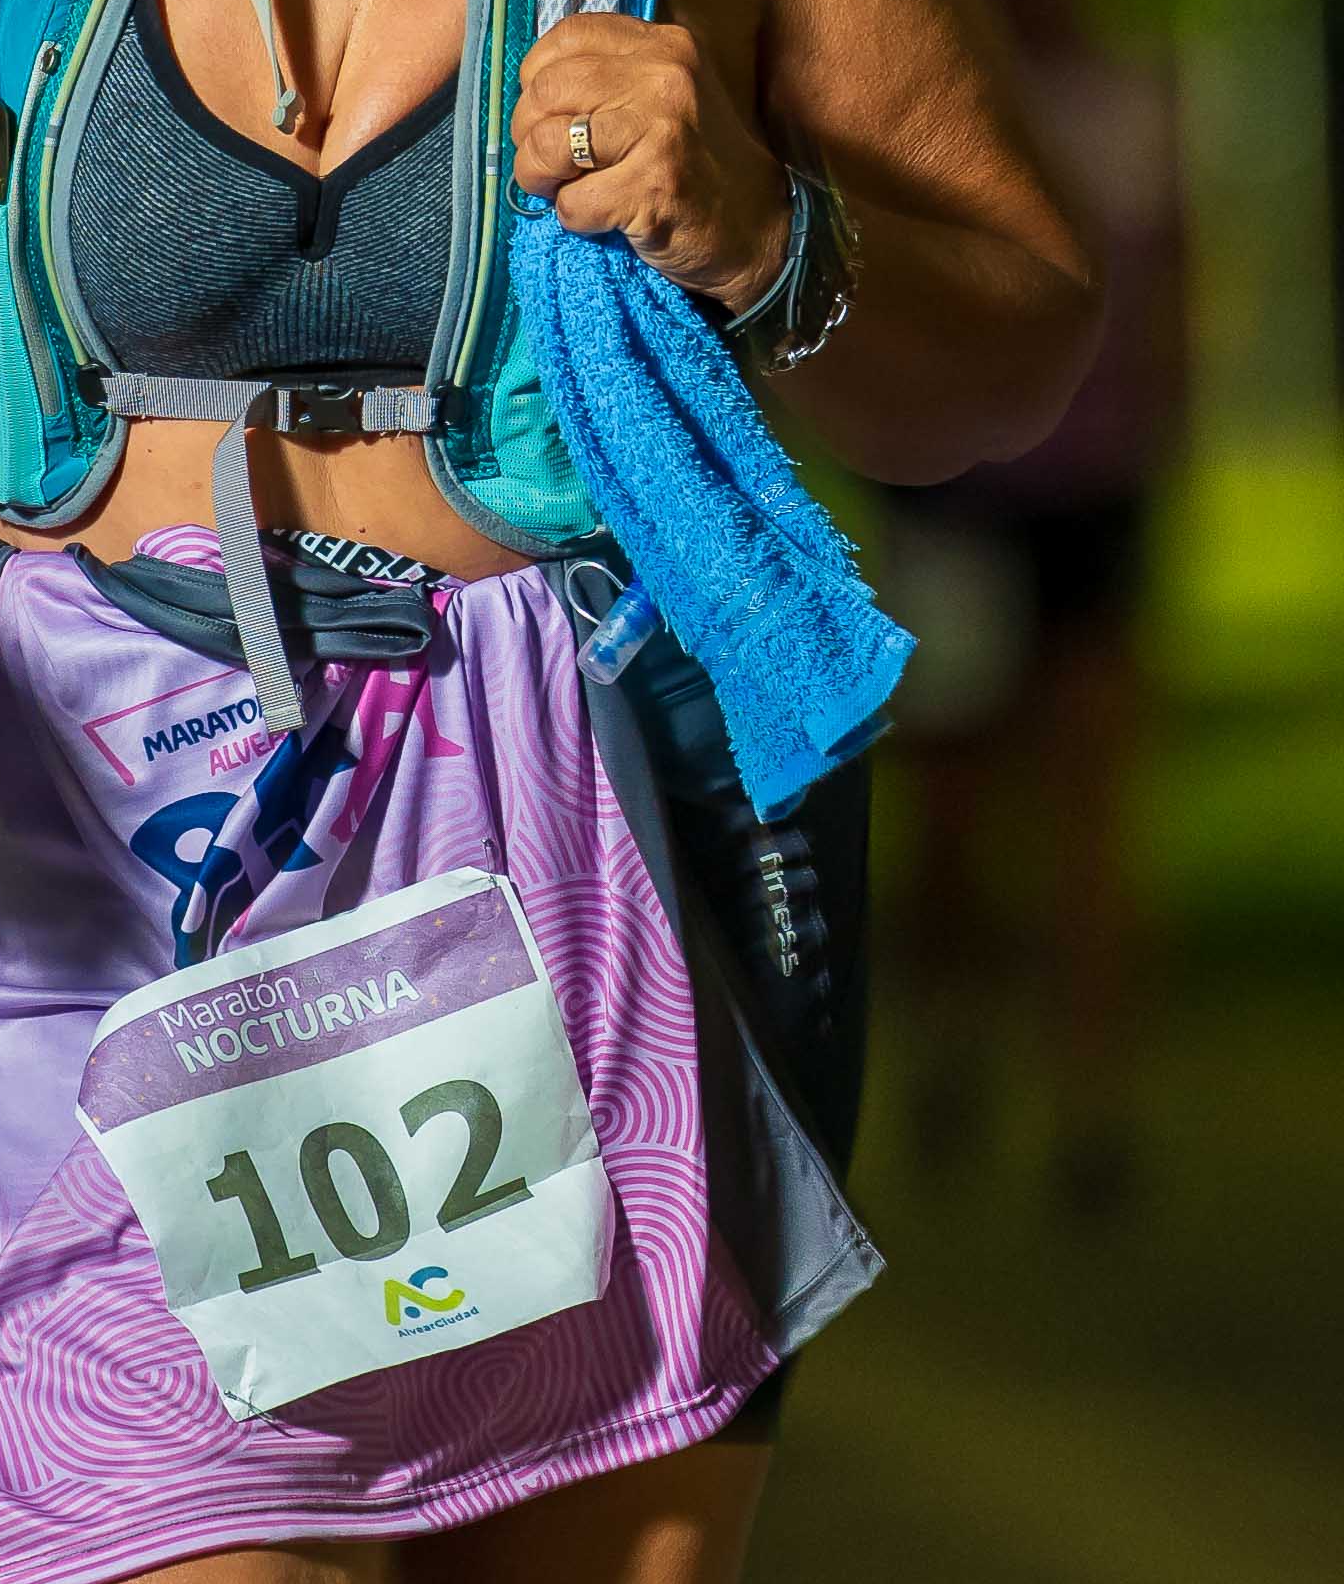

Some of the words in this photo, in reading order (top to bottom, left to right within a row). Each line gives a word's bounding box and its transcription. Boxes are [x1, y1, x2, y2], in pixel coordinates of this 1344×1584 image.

[142, 695, 263, 763] MARATO
[158, 973, 301, 1038] Maratón
[175, 969, 422, 1075] NOCTURNA
[206, 1079, 534, 1294] 102
